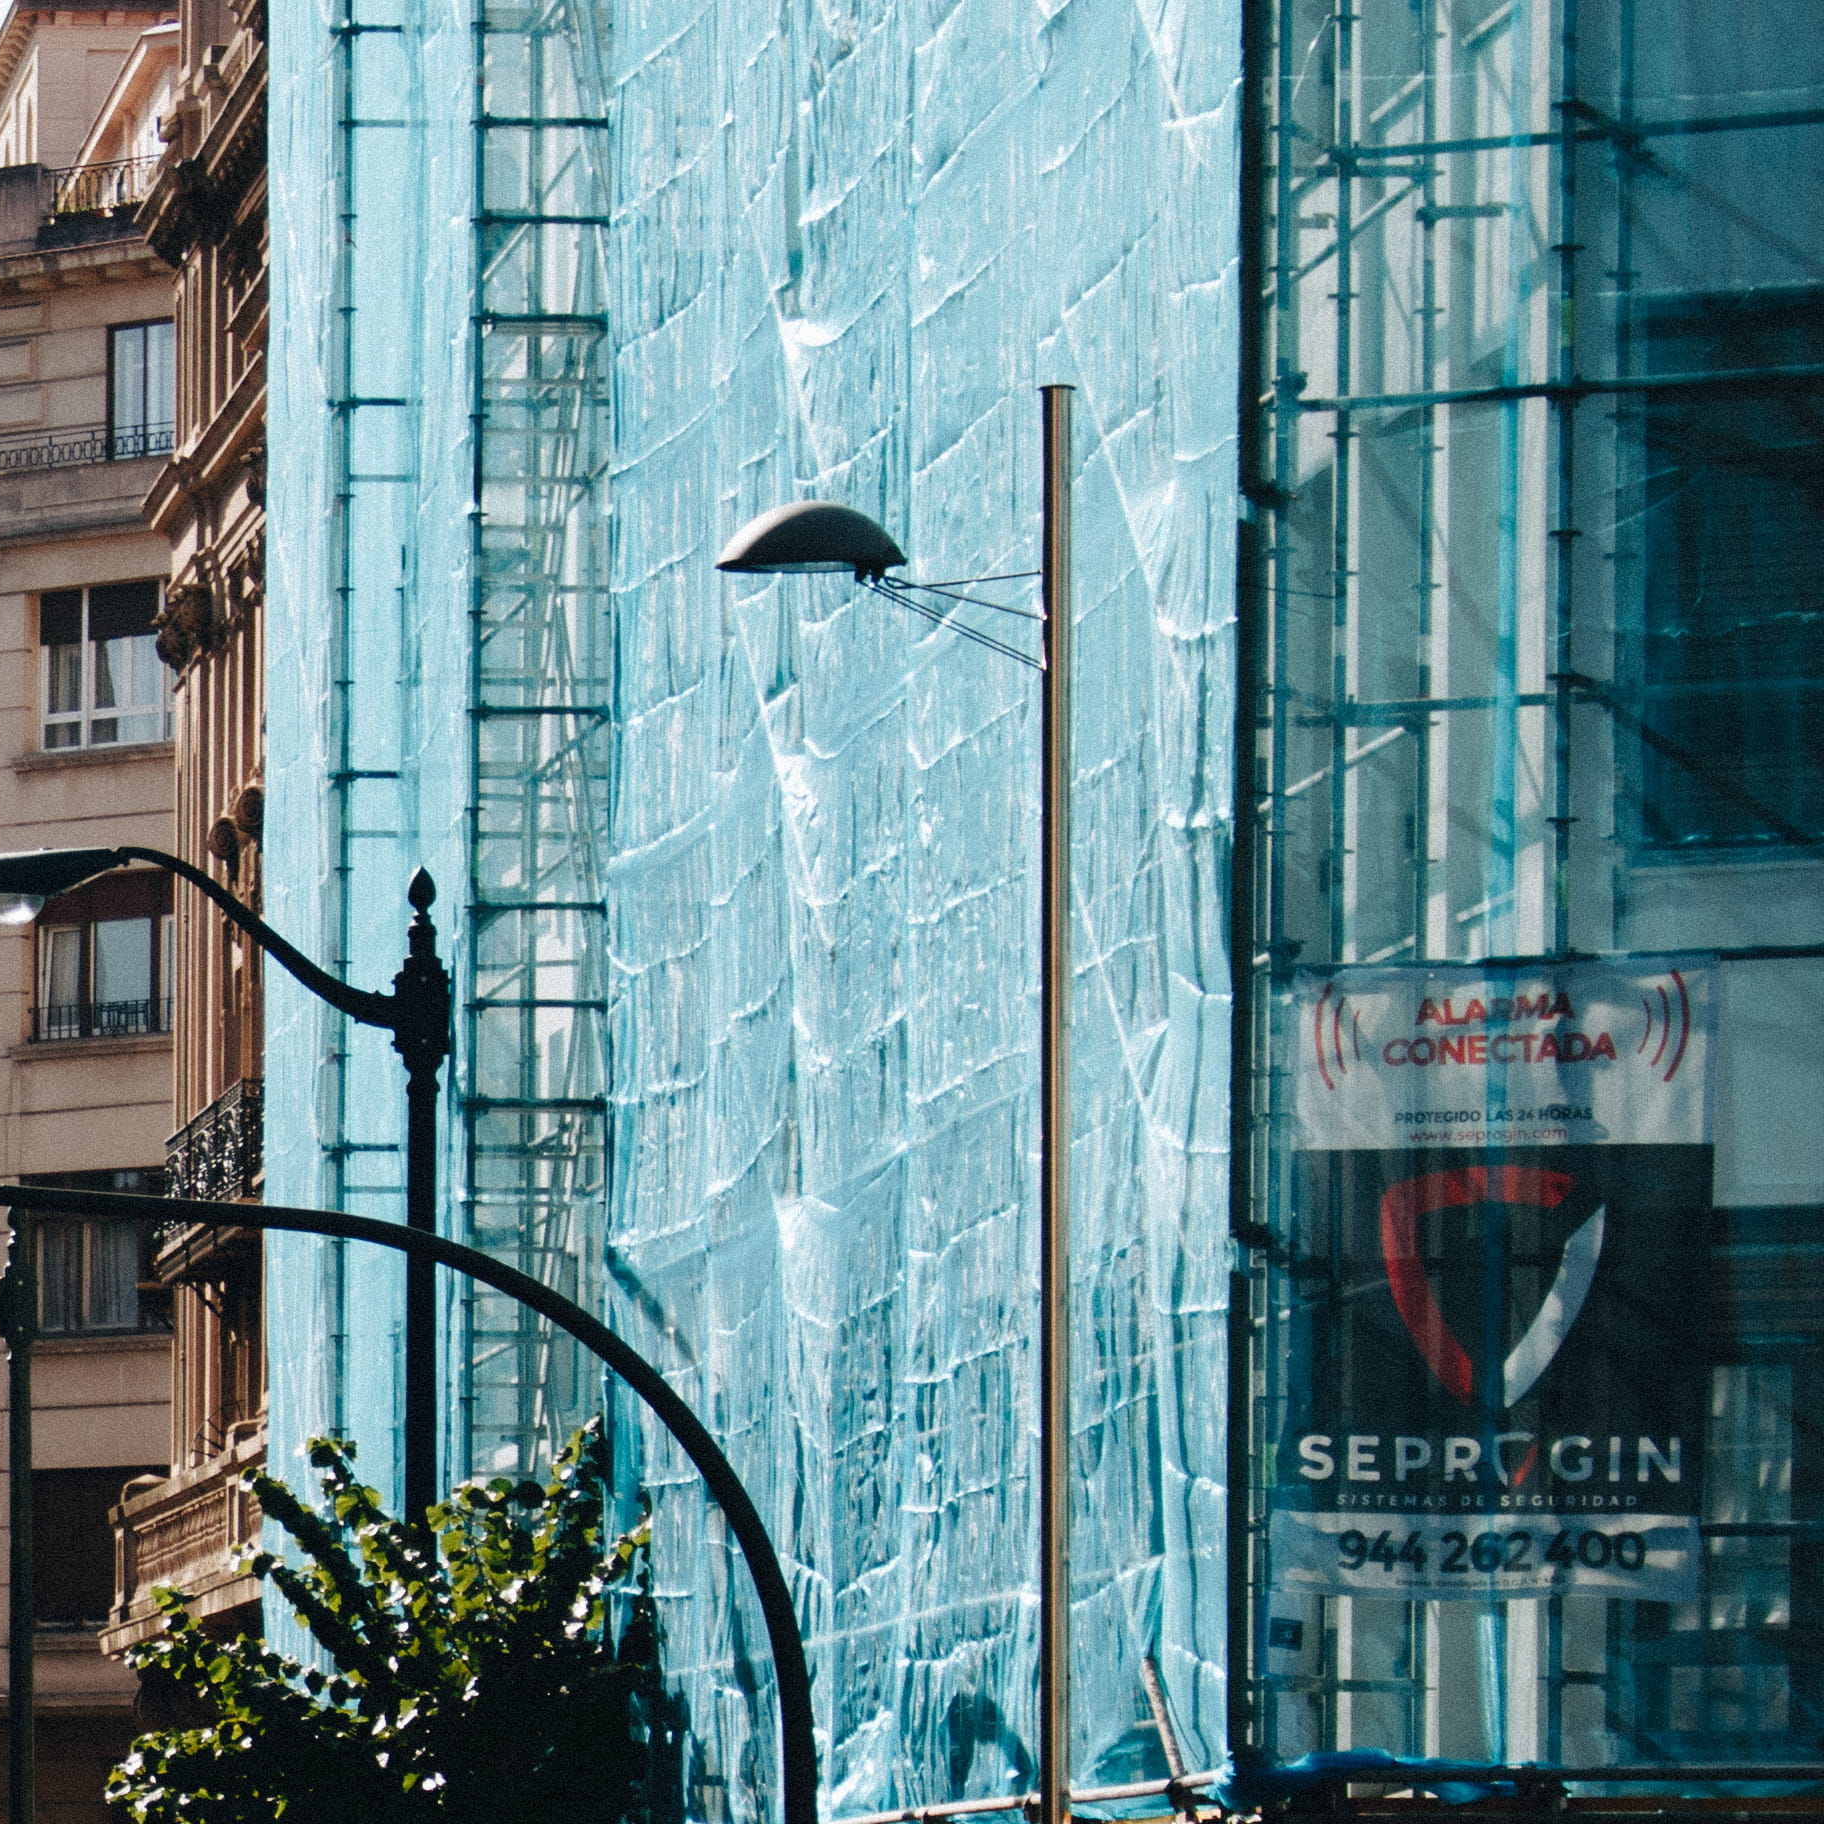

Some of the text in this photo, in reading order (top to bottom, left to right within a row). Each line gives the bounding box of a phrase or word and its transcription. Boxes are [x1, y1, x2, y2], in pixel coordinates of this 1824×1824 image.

[1415, 991, 1576, 1025] ALARMA
[1383, 1031, 1617, 1066] CONECTADA
[1394, 1106, 1593, 1124] PROTEGIDO LAS 24 HORAS
[1336, 1493, 1638, 1507] SISTEMAS DE SEGURIDAD
[1337, 1528, 1647, 1574] 944 262 400
